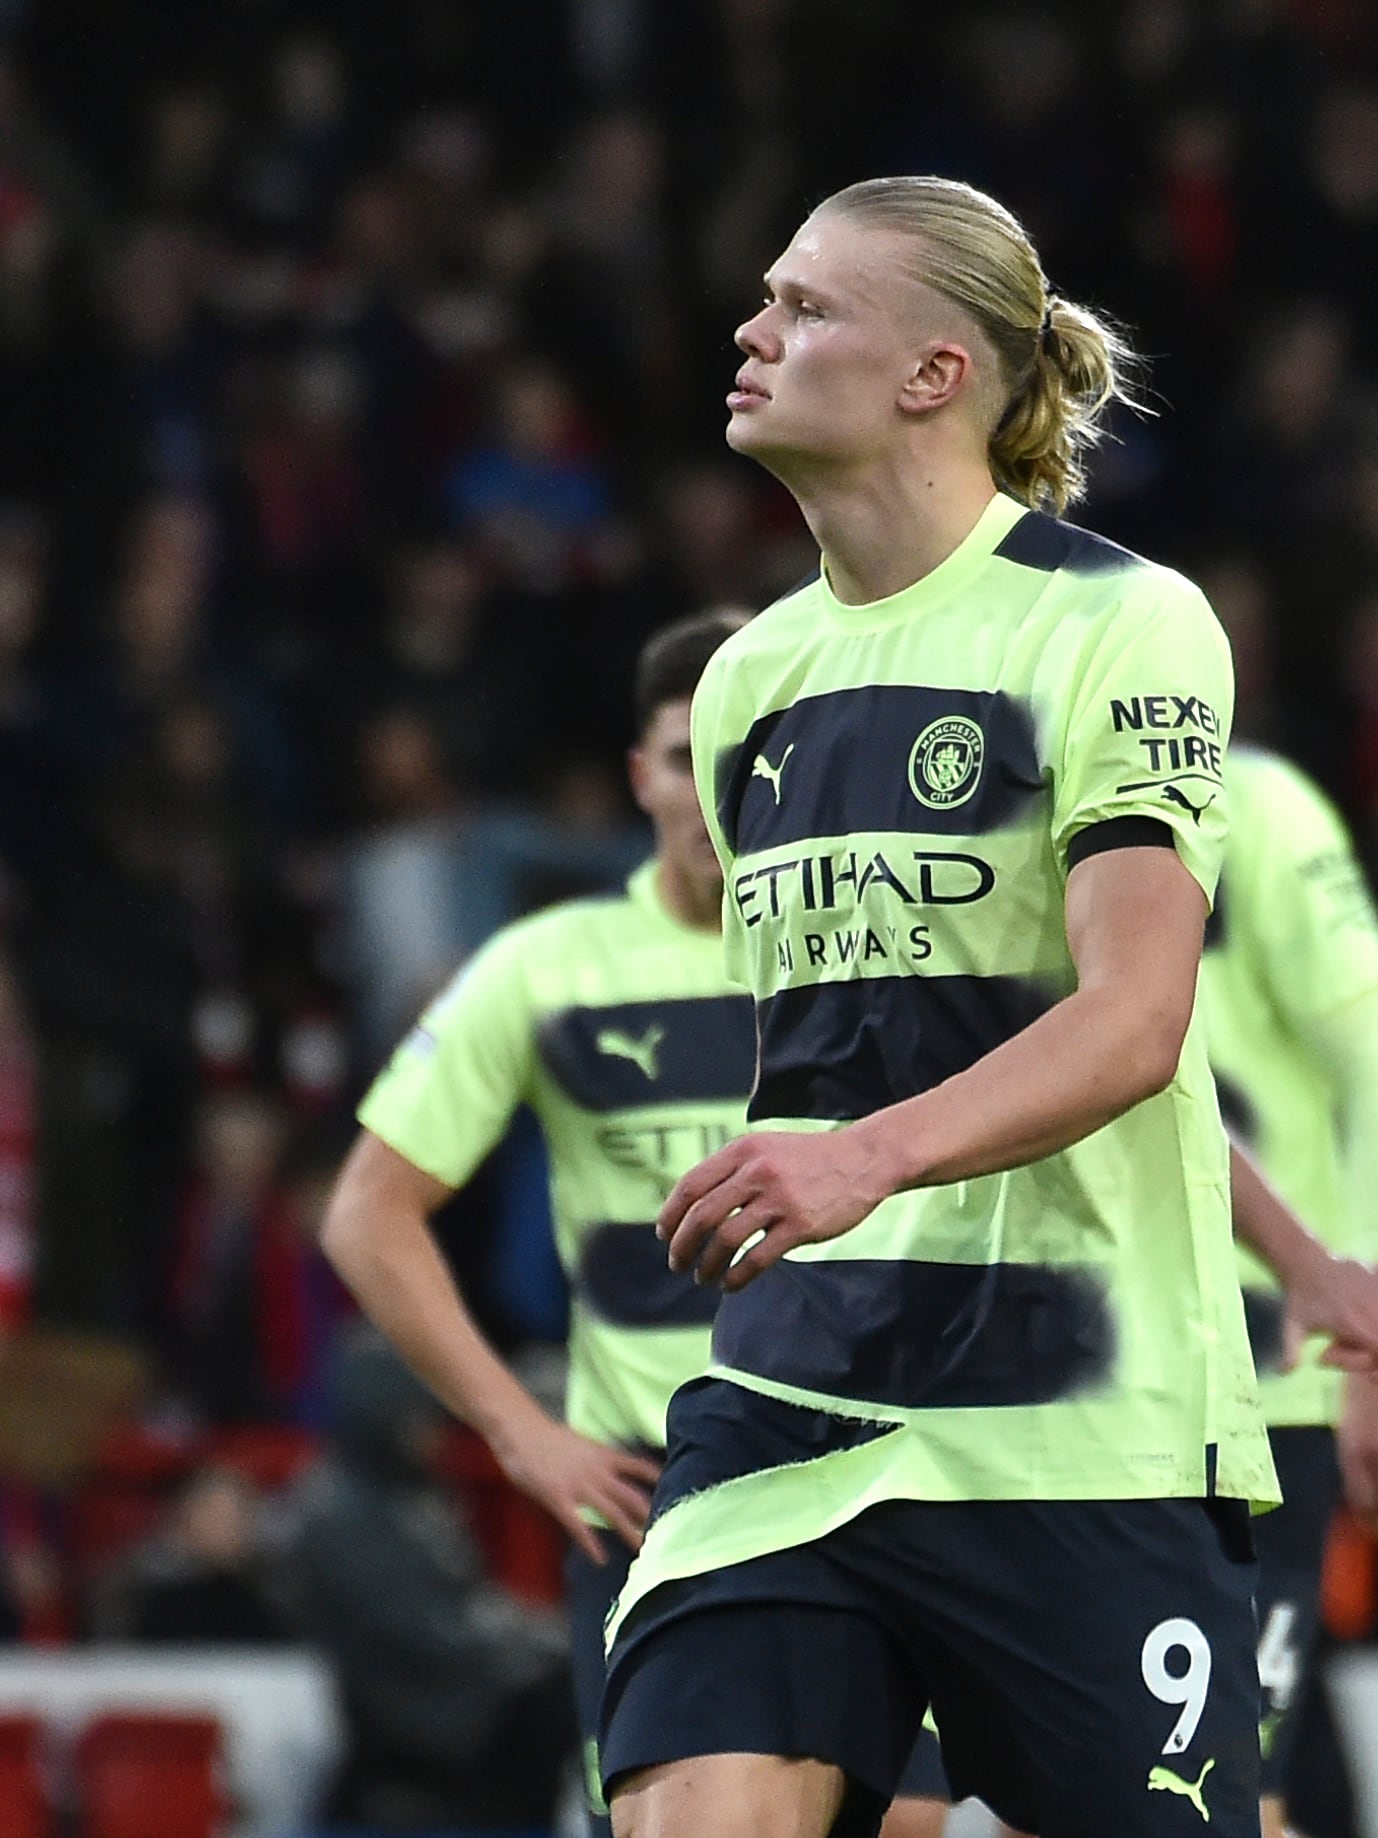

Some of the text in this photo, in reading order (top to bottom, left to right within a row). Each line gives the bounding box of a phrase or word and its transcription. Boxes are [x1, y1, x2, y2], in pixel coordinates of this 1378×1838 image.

[920, 723, 981, 753] MANCHESTER
[1138, 735, 1223, 778] TIRE
[930, 792, 954, 802] CITY
[735, 852, 996, 928] ETIHAD
[1141, 1616, 1211, 1755] 9
